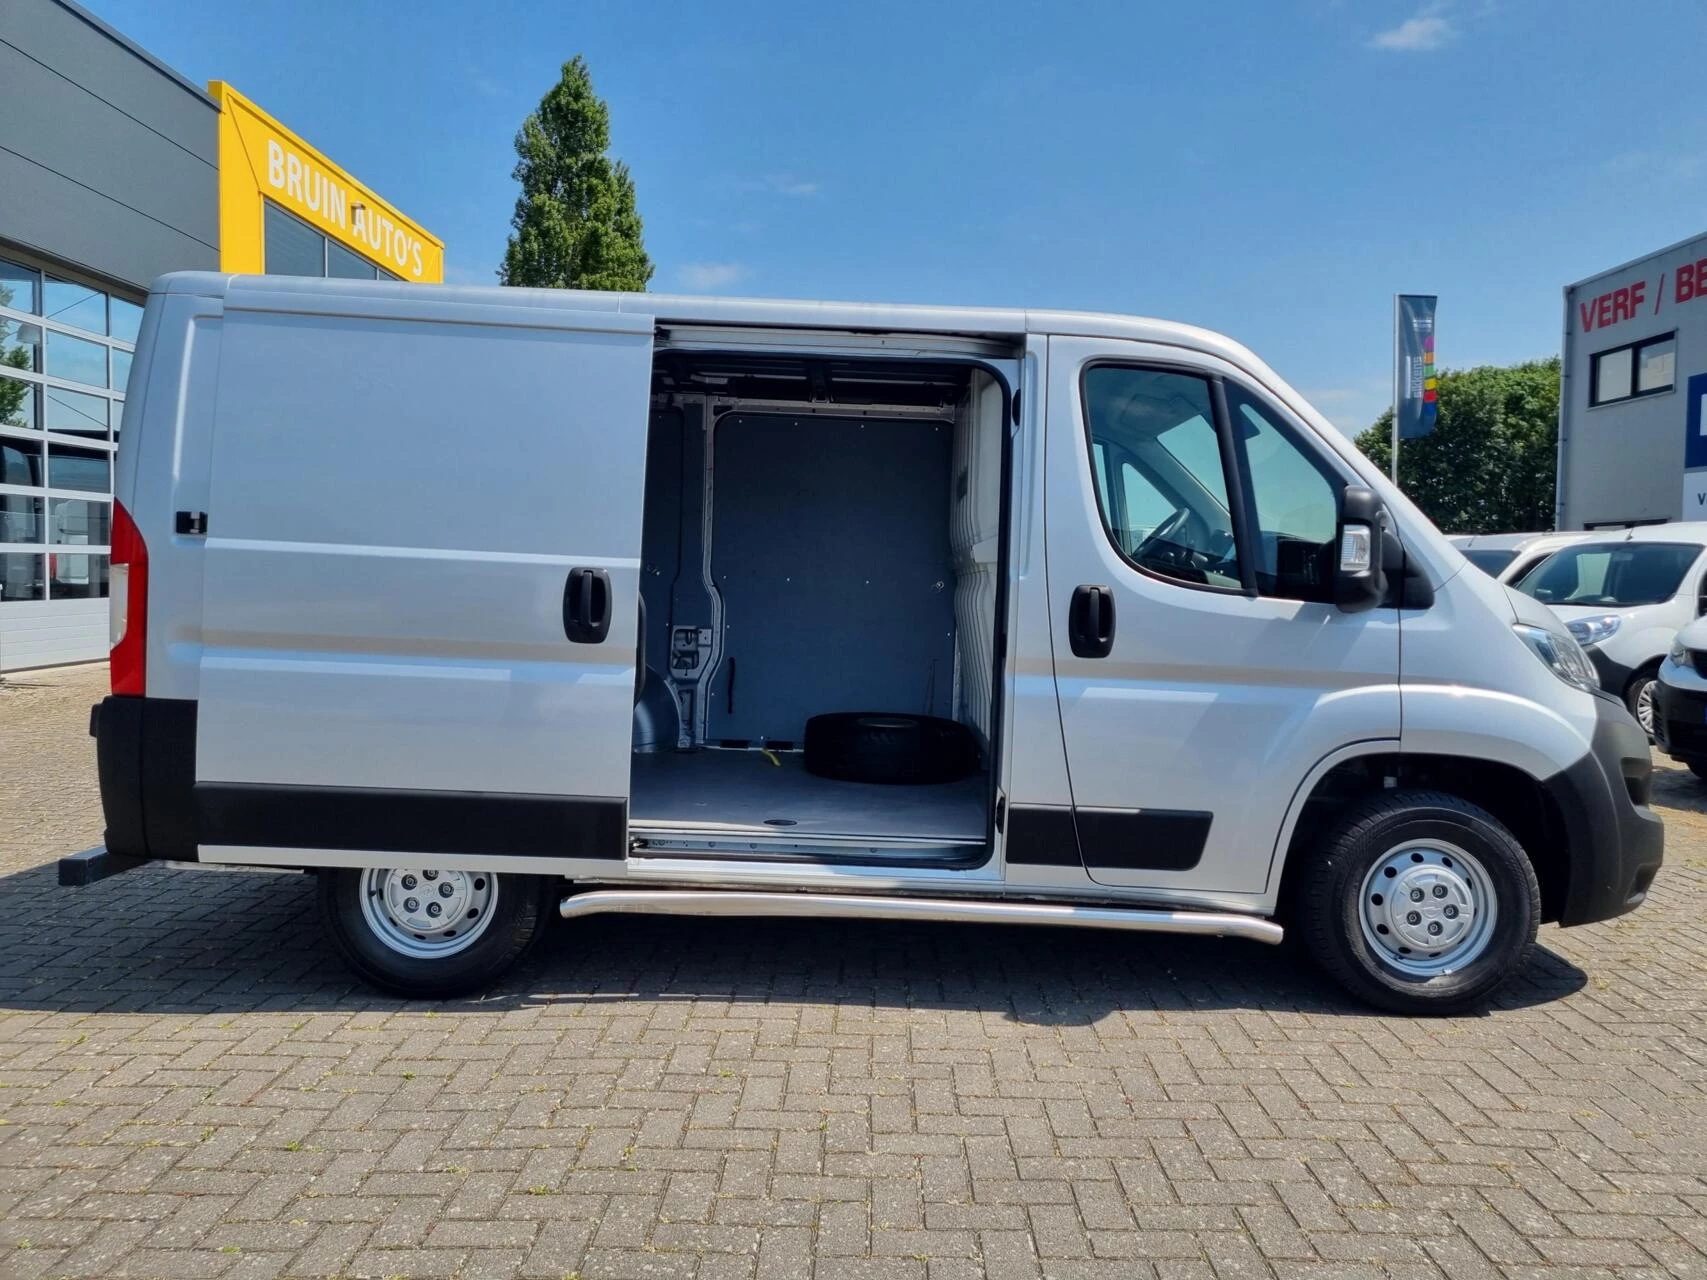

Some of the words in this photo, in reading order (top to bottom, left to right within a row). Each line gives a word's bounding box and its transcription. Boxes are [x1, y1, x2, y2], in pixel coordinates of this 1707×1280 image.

[268, 140, 346, 230] BRUIN
[353, 207, 423, 276] AUTO'S
[1580, 281, 1646, 333] VERF
